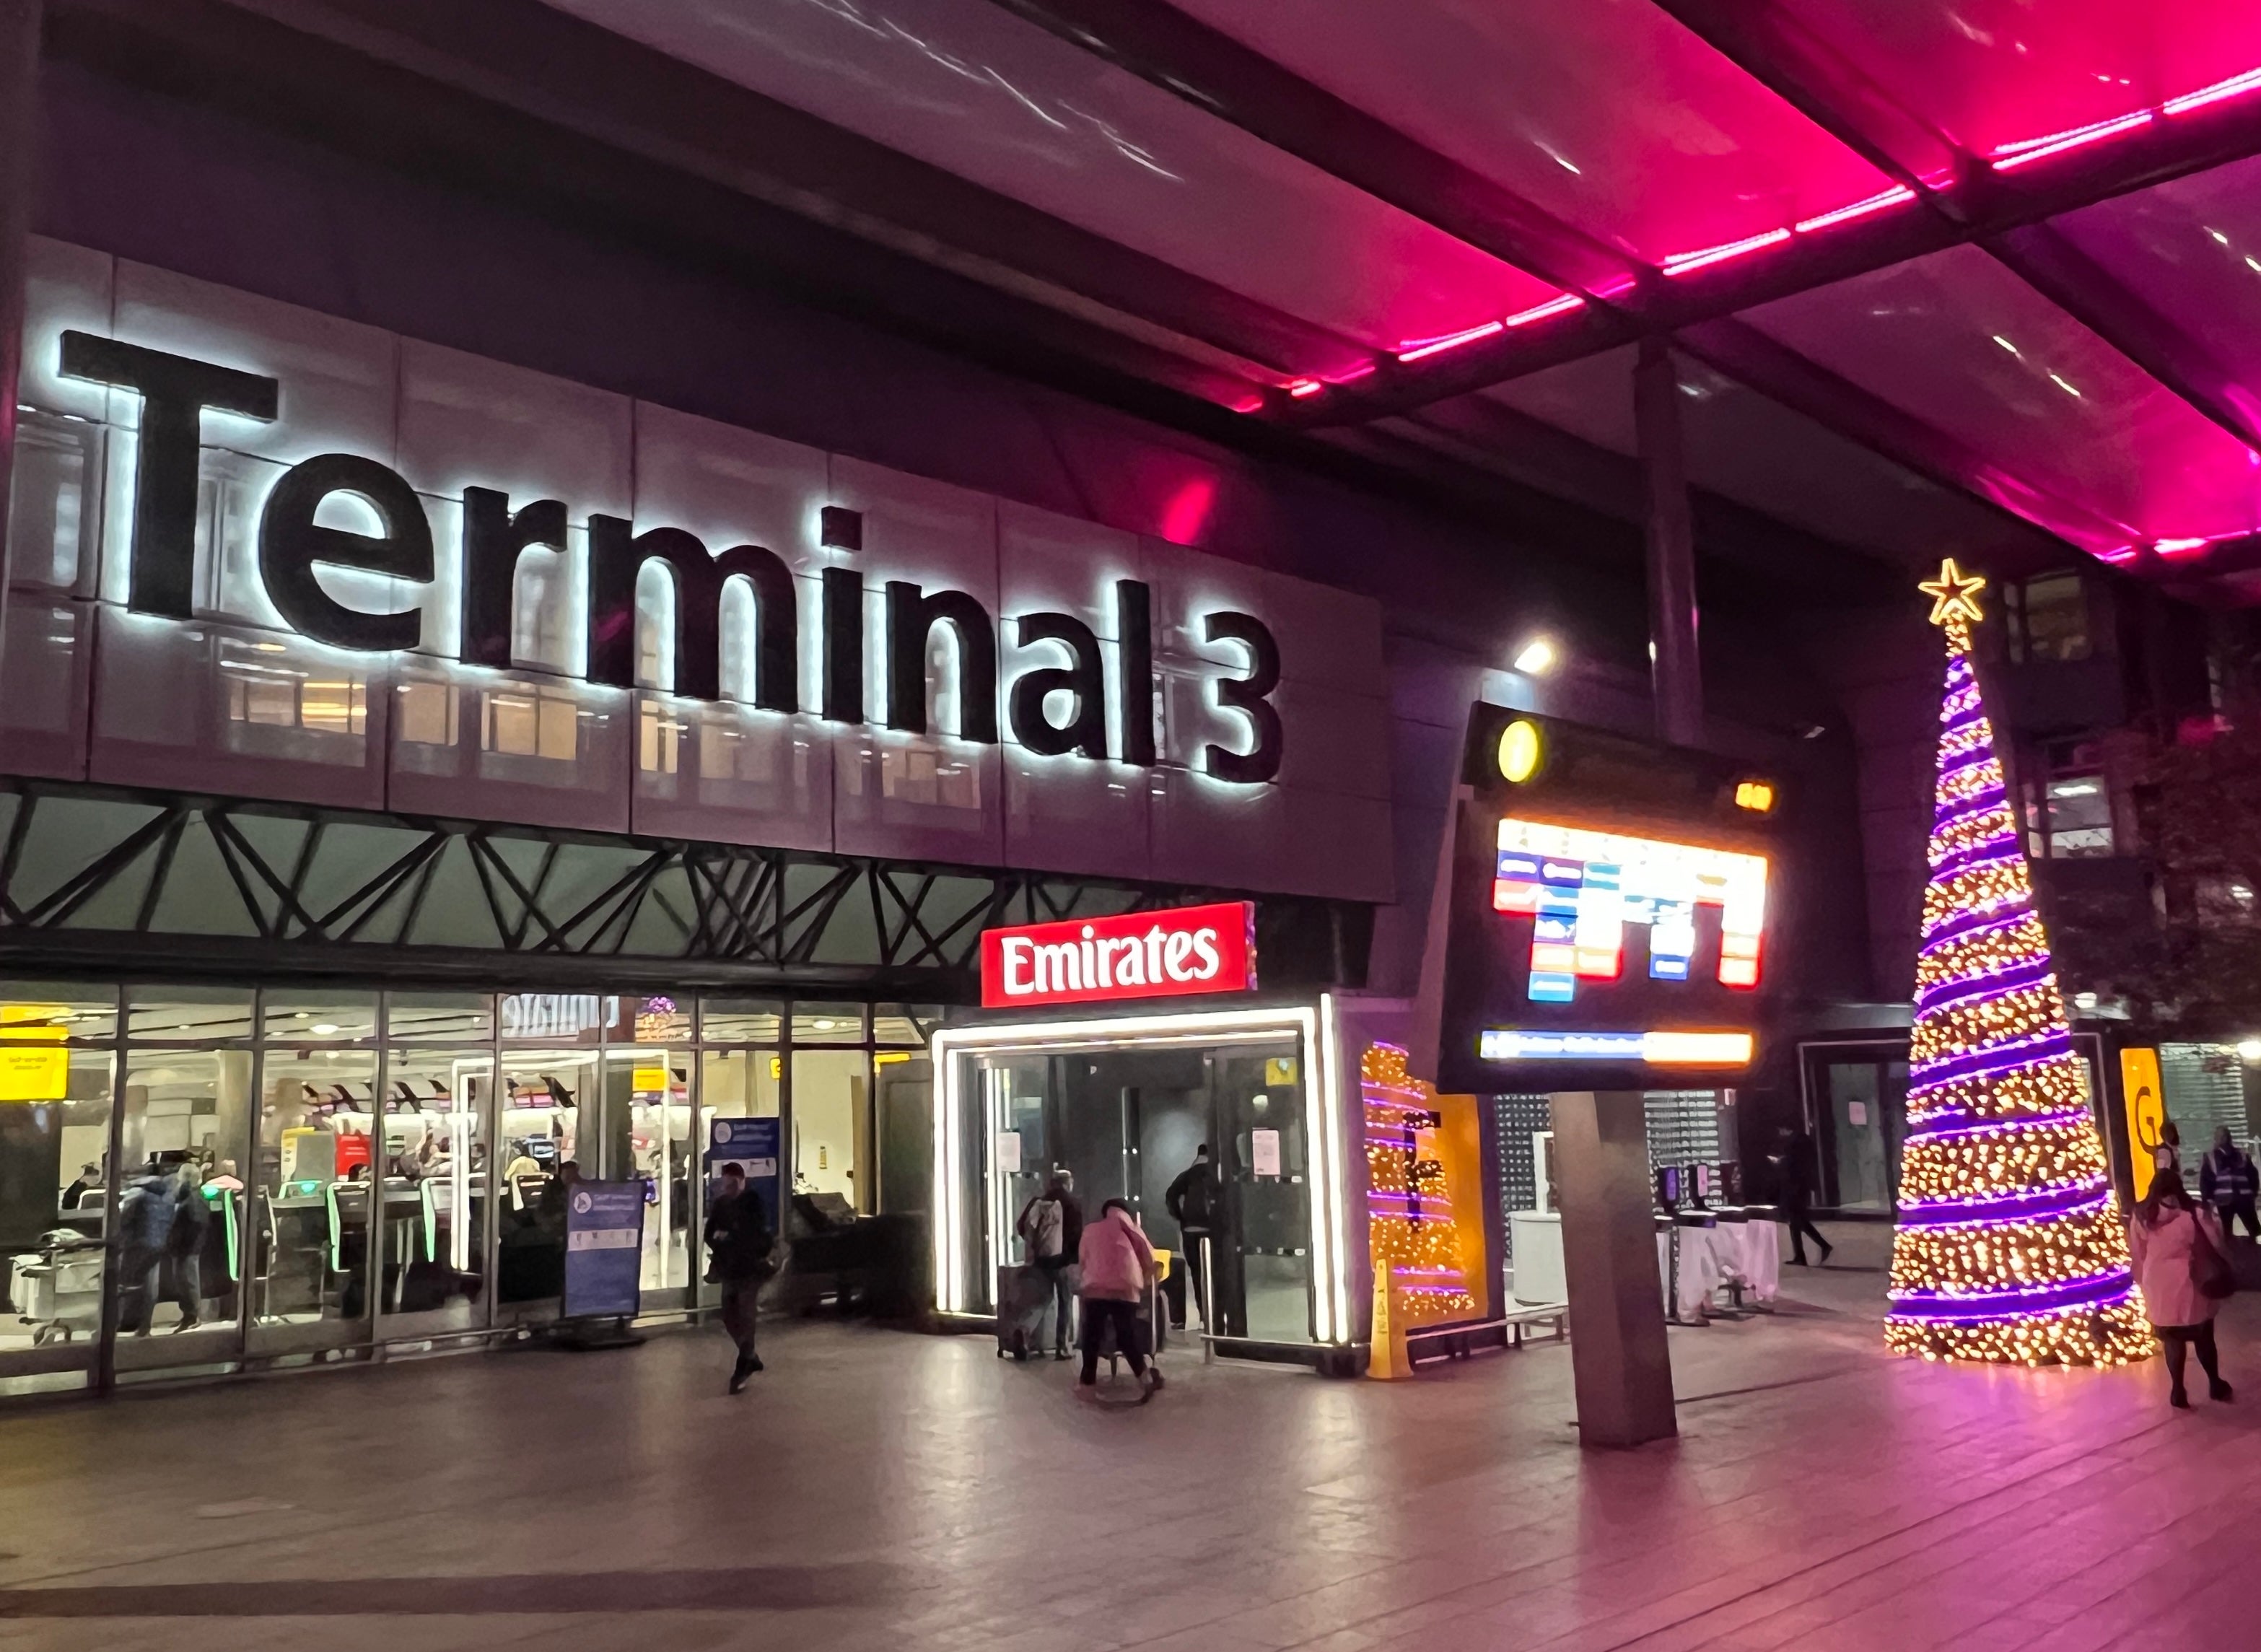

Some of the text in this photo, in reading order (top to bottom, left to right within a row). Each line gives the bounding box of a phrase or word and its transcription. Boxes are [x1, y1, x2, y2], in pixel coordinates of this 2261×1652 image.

[58, 330, 1283, 784] Terminal 3
[1001, 925, 1220, 995] Emirates
[2135, 1085, 2158, 1157] G
[1403, 1111, 1444, 1234] F
